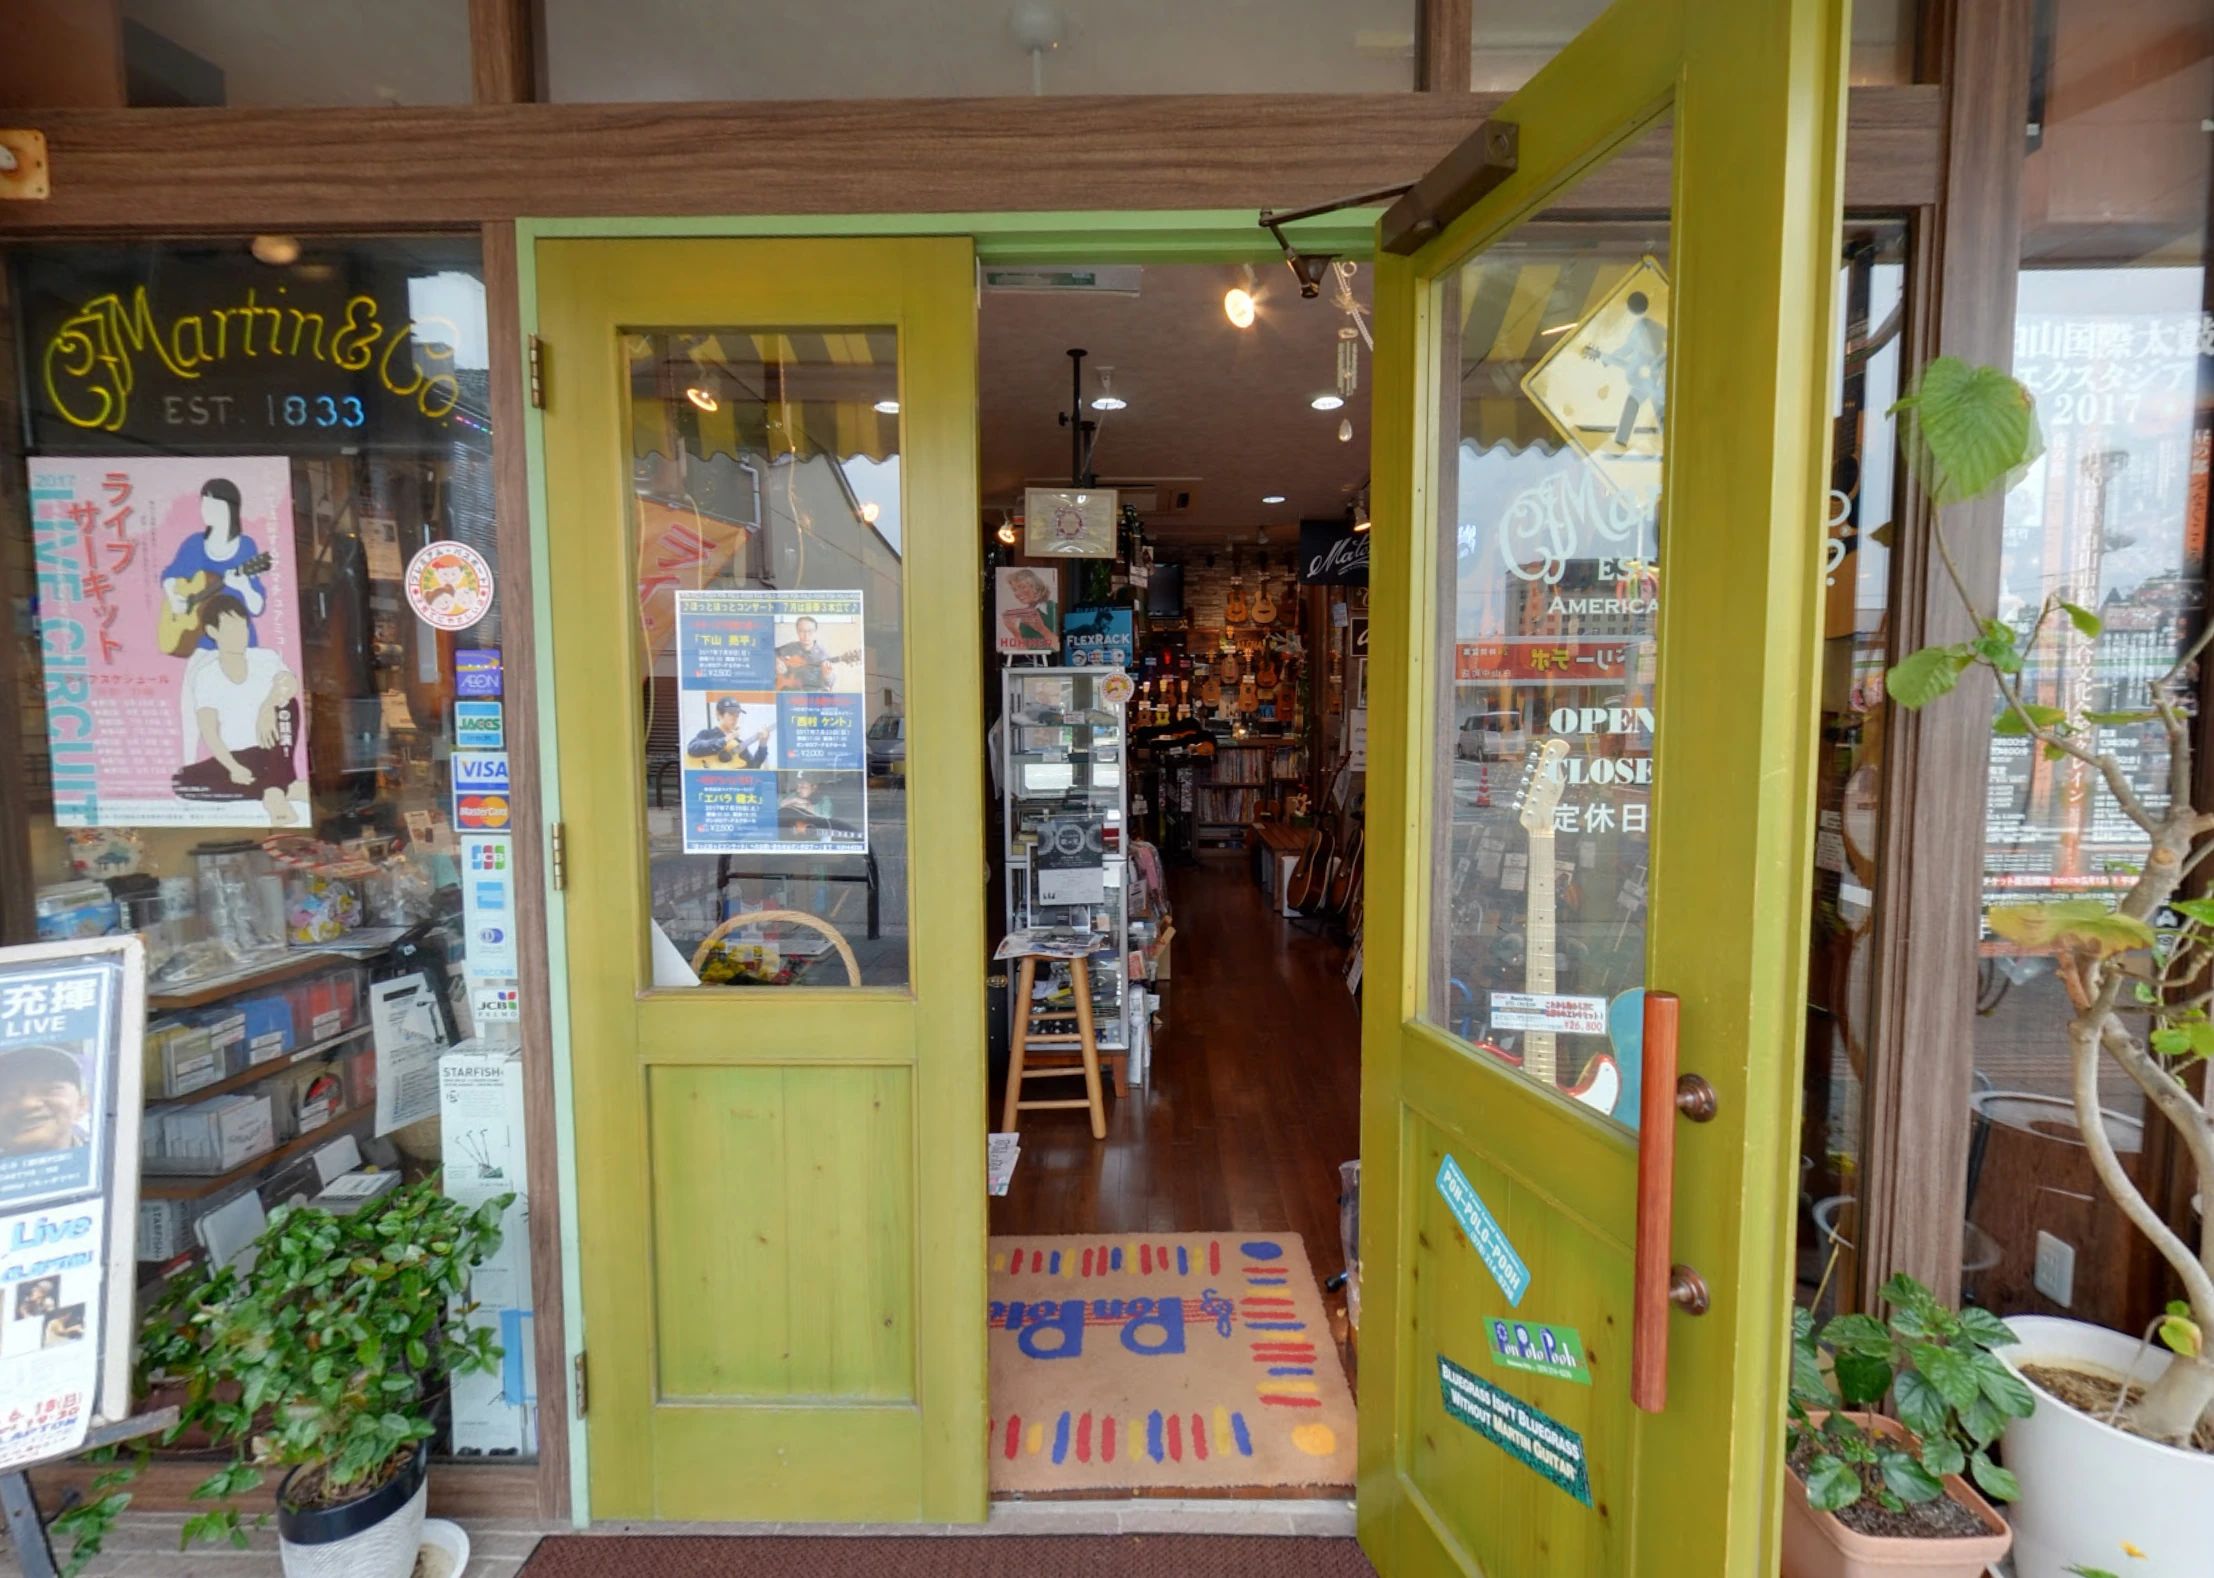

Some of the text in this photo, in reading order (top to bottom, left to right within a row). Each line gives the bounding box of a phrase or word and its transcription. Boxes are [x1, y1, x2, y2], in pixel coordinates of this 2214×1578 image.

[267, 394, 365, 427] 1833
[2050, 393, 2142, 426] 2017
[68, 500, 124, 666] サーキット
[1547, 596, 1659, 615] AMERICA
[30, 488, 100, 827] LIVE CIRCUIT
[458, 718, 501, 731] JACCS
[1549, 706, 1656, 734] OPEN
[463, 761, 508, 778] VISA
[1551, 802, 1648, 834] 定休日
[477, 1001, 508, 1011] JCB
[5, 1015, 66, 1039] LIVE
[9, 1215, 93, 1255] Live
[1540, 1328, 1577, 1368] Pooh
